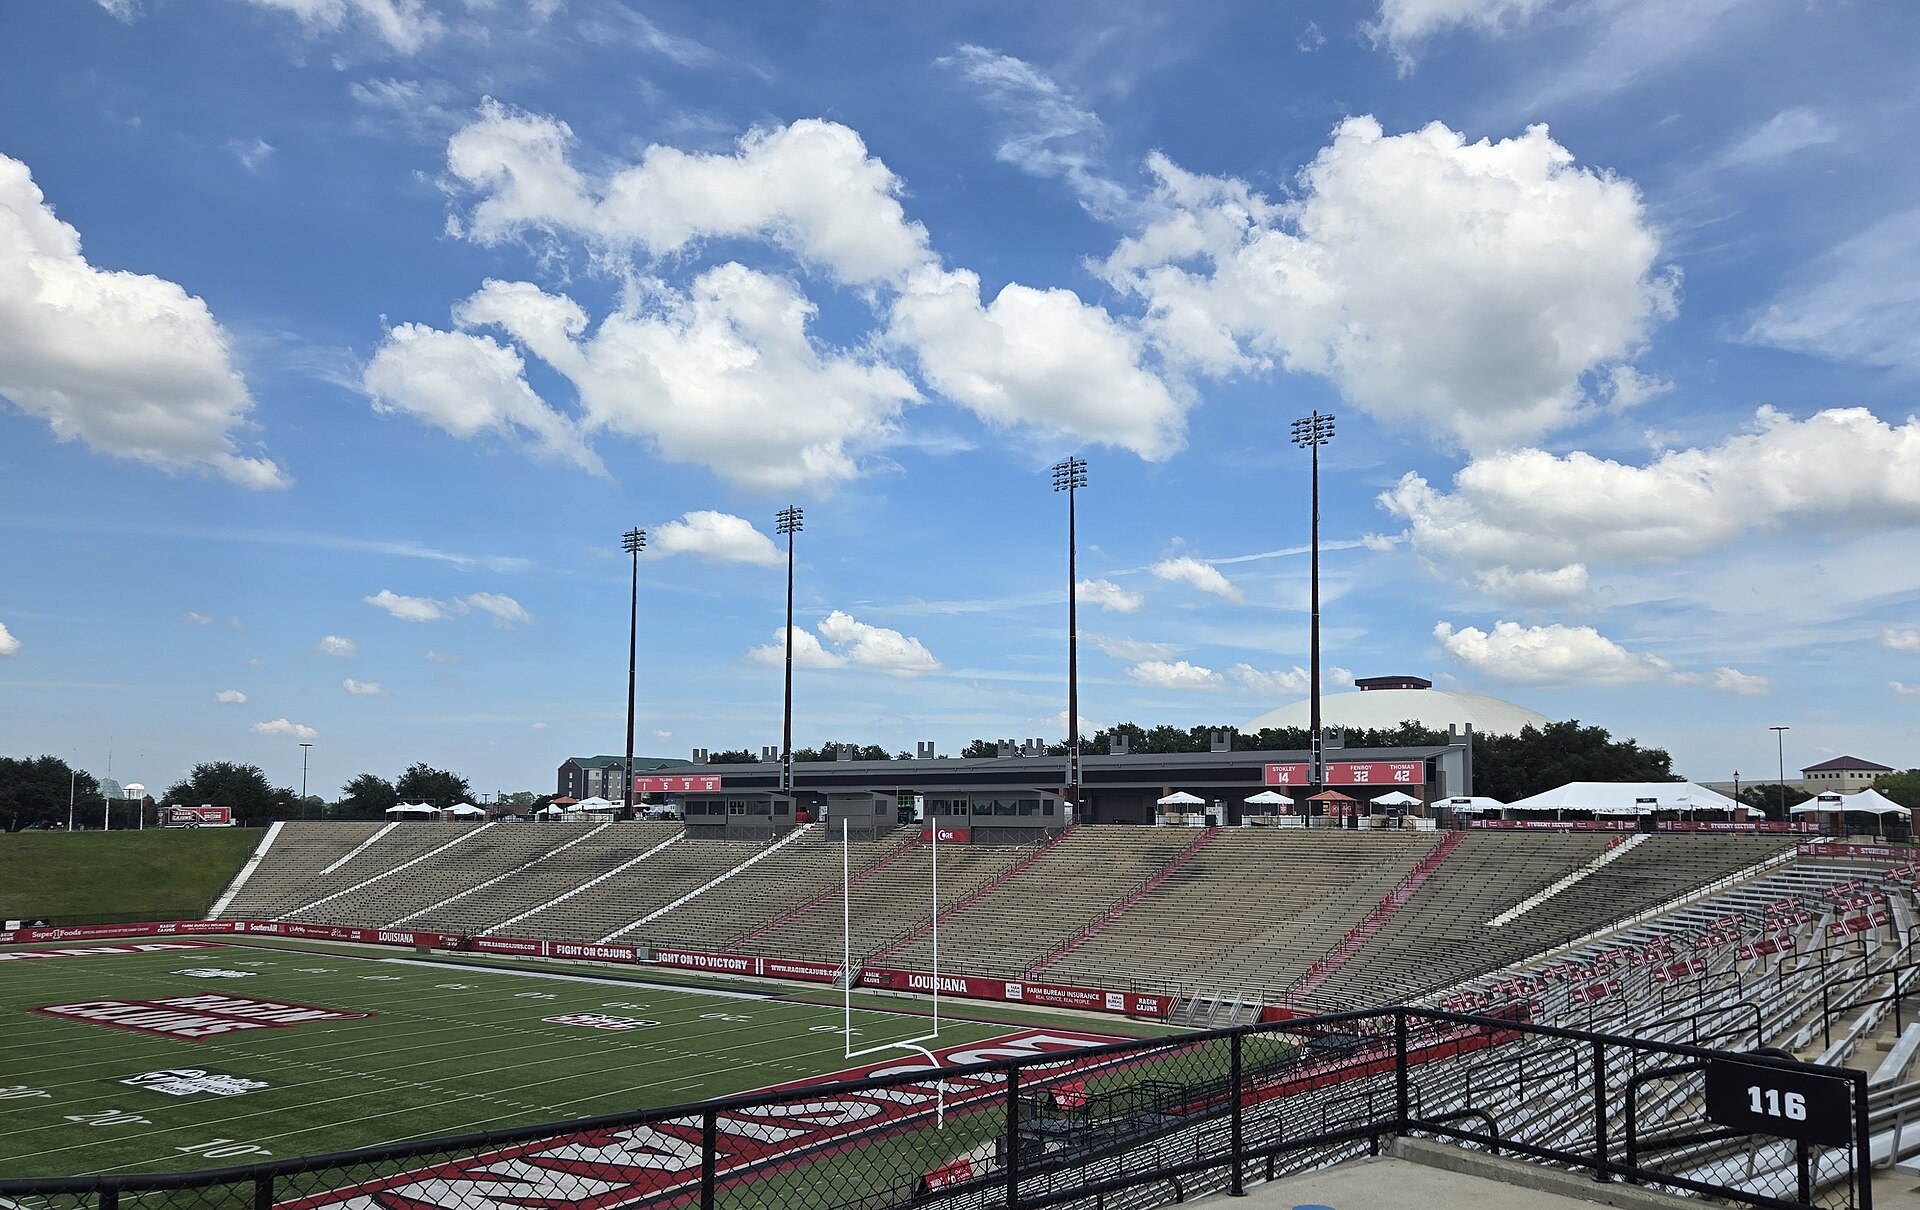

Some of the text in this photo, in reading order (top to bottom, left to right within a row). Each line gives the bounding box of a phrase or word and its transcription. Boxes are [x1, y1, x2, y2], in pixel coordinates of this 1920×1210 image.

[1278, 772, 1289, 783] 14
[1353, 770, 1369, 782] 32
[1393, 770, 1410, 782] 42
[663, 782, 669, 790] 5
[378, 931, 414, 943] LOUISIANA
[556, 944, 632, 959] FIGHT ON CAJUNS
[657, 952, 748, 970] IGHT ON TO VICTORY
[908, 974, 968, 993] LOUISIANA
[1026, 987, 1043, 995] FARM
[1043, 988, 1066, 997] BUREAU
[1066, 990, 1100, 1000] INSURANCE
[1136, 1004, 1158, 1012] CAJUNS
[1747, 1086, 1807, 1121] 116
[175, 1138, 262, 1158] 10
